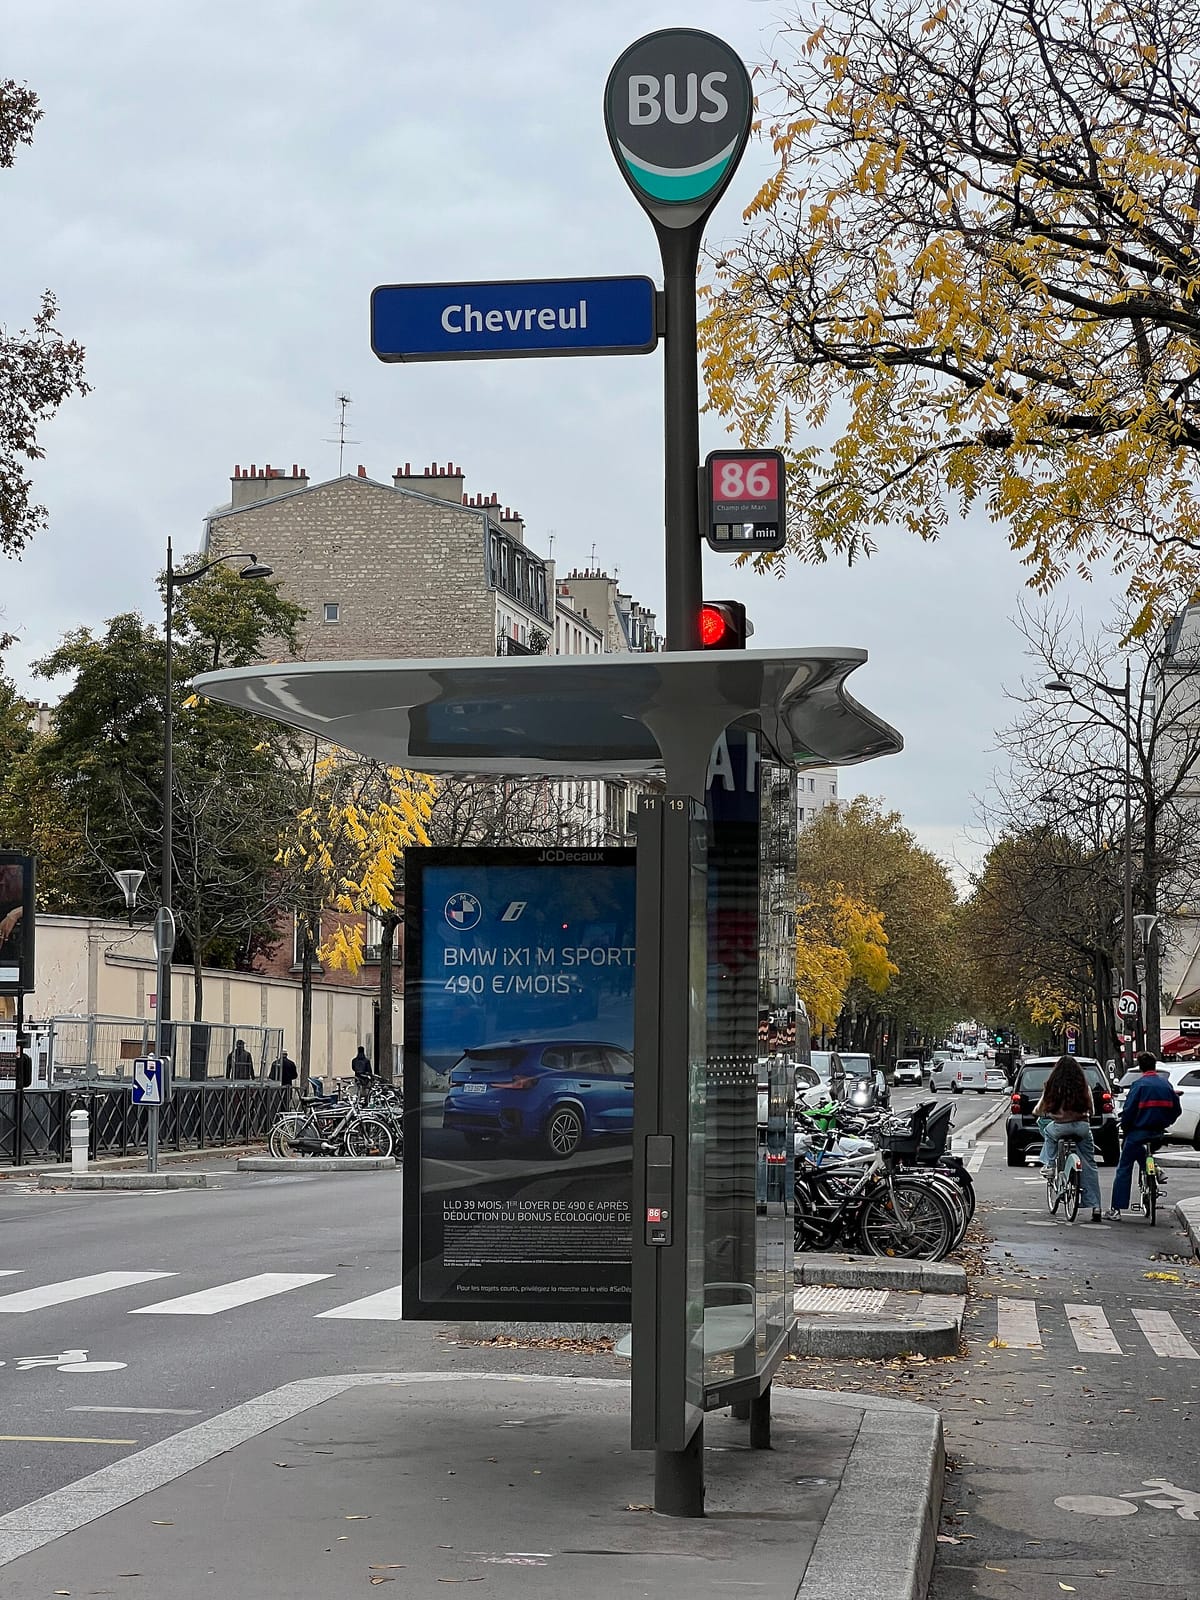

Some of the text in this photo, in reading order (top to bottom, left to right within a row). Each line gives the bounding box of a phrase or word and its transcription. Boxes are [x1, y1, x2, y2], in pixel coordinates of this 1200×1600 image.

[628, 71, 729, 126] BUS
[441, 300, 587, 333] Chevreul
[720, 462, 771, 497] 86
[717, 504, 739, 512] Champ
[743, 523, 776, 538] 7 min
[643, 799, 656, 809] 11
[669, 800, 684, 810] 19
[538, 850, 604, 862] JCDecaux
[444, 948, 497, 966] BMW
[503, 948, 530, 966] iX1
[537, 948, 555, 966] M
[444, 976, 484, 994] 490
[1119, 998, 1137, 1014] 30
[443, 1200, 462, 1210] LLD
[464, 1200, 475, 1210] 39
[477, 1200, 504, 1210] MOIS.
[519, 1201, 550, 1210] LOYER
[552, 1201, 566, 1210] DE
[568, 1201, 586, 1210] 490
[588, 1201, 595, 1210] €
[596, 1199, 629, 1210] APRÈS
[443, 1210, 631, 1222] DÉDUCTION DU BONUS ÉCOLOGIQUE DE
[649, 1208, 659, 1217] 86
[471, 1284, 480, 1292] les
[480, 1284, 500, 1292] trajets
